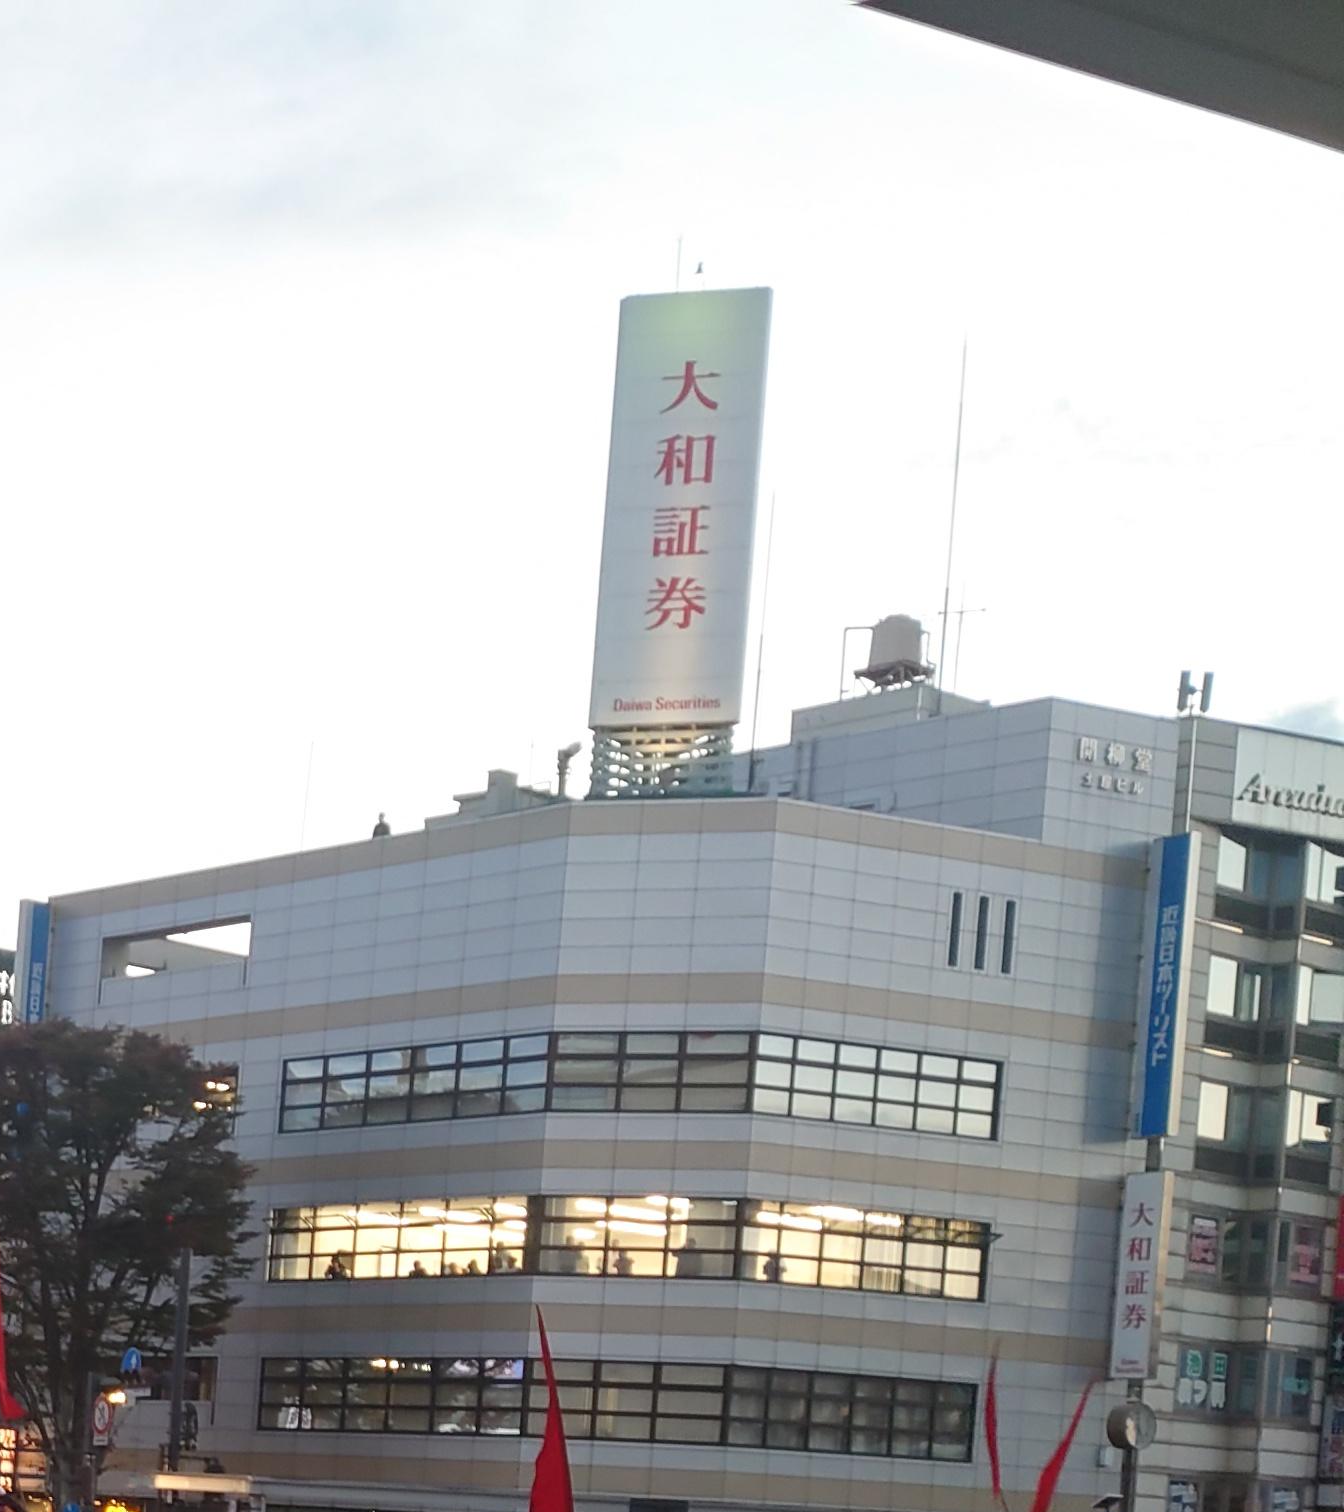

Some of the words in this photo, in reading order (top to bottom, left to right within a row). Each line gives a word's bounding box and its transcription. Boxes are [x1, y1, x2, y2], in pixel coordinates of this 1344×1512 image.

[645, 360, 721, 631] 大和証券
[613, 697, 653, 713] Daiwa
[655, 695, 720, 711] Securities
[1121, 1202, 1155, 1331] 大和証券
